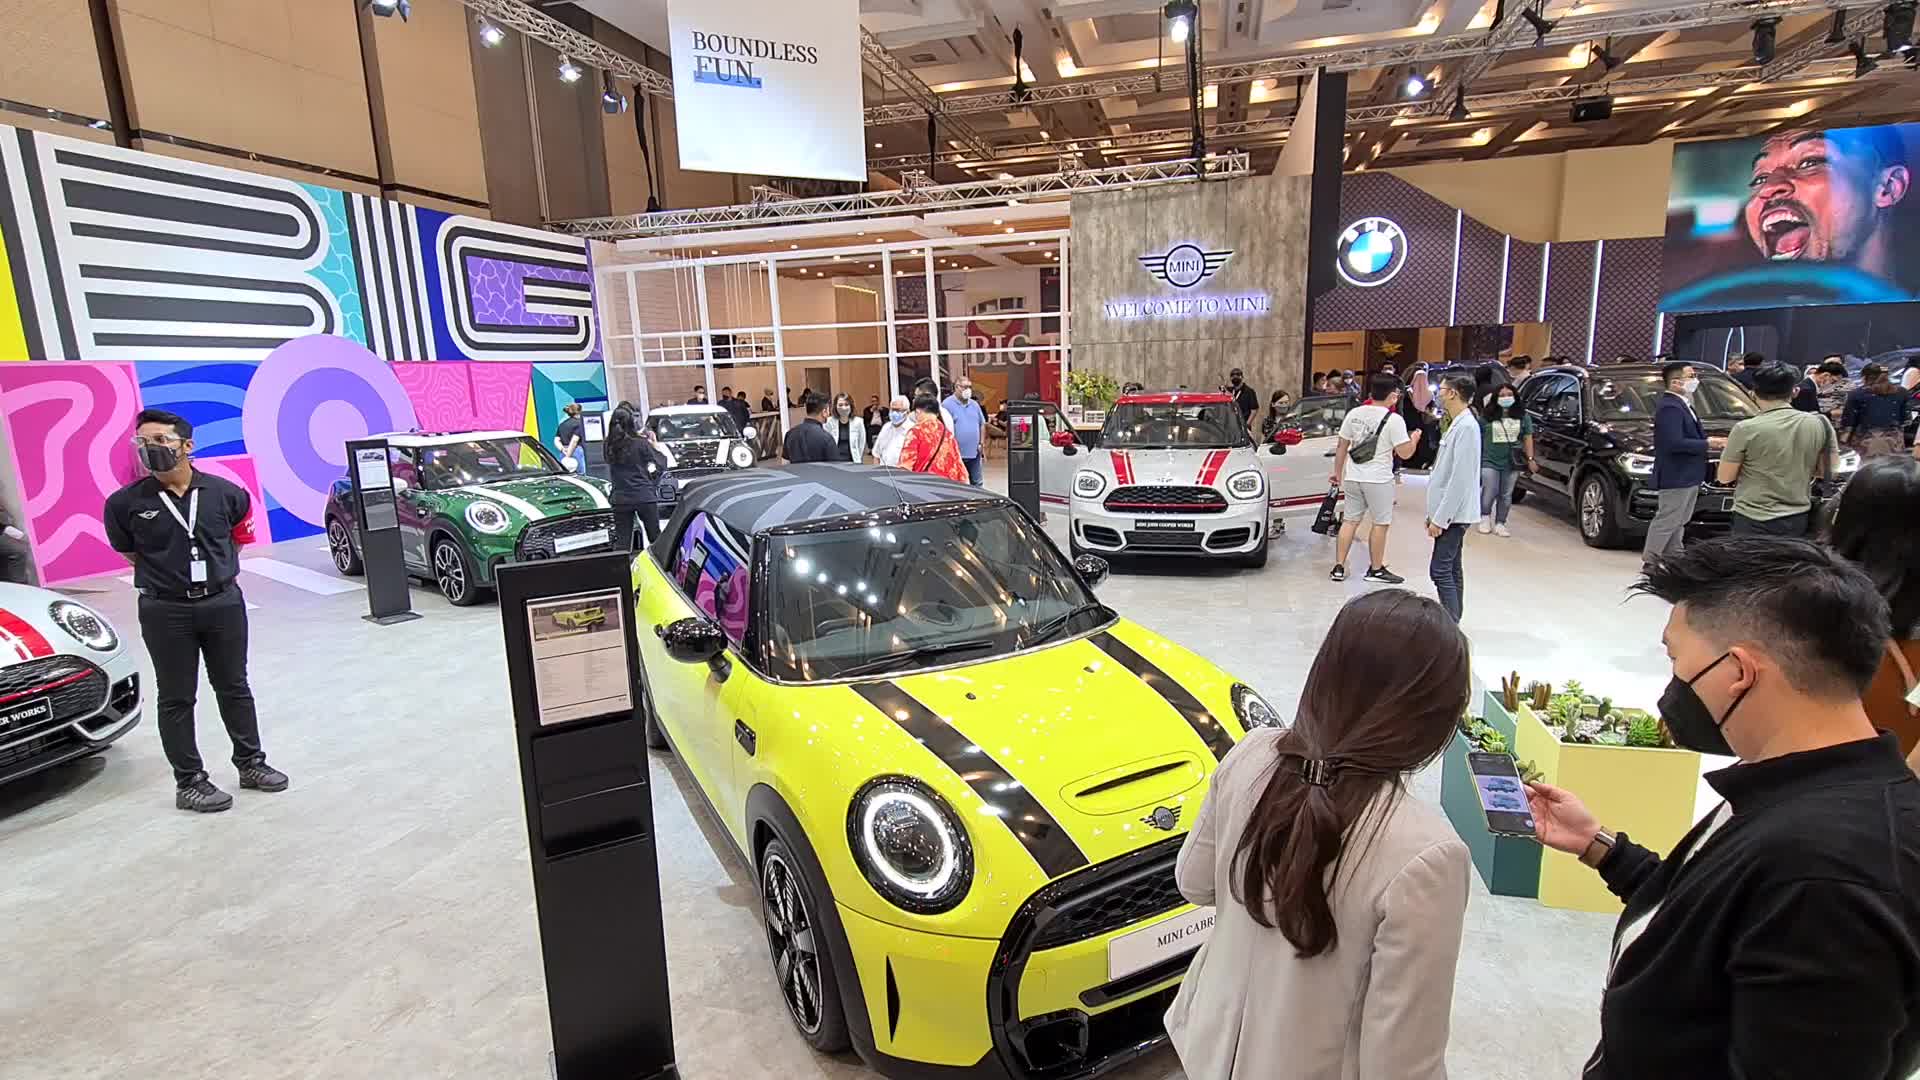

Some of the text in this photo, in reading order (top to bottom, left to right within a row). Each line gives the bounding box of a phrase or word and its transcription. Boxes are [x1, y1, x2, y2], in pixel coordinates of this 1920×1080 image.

[692, 30, 818, 65] BOUNDLESS
[694, 55, 761, 85] FUN.
[1343, 219, 1400, 243] BMW
[1169, 260, 1200, 273] MINI
[1105, 296, 1270, 318] WELCOME TO MINI.
[968, 334, 1033, 367] BIG
[10, 705, 47, 721] WORKS
[1157, 928, 1183, 948] MINI
